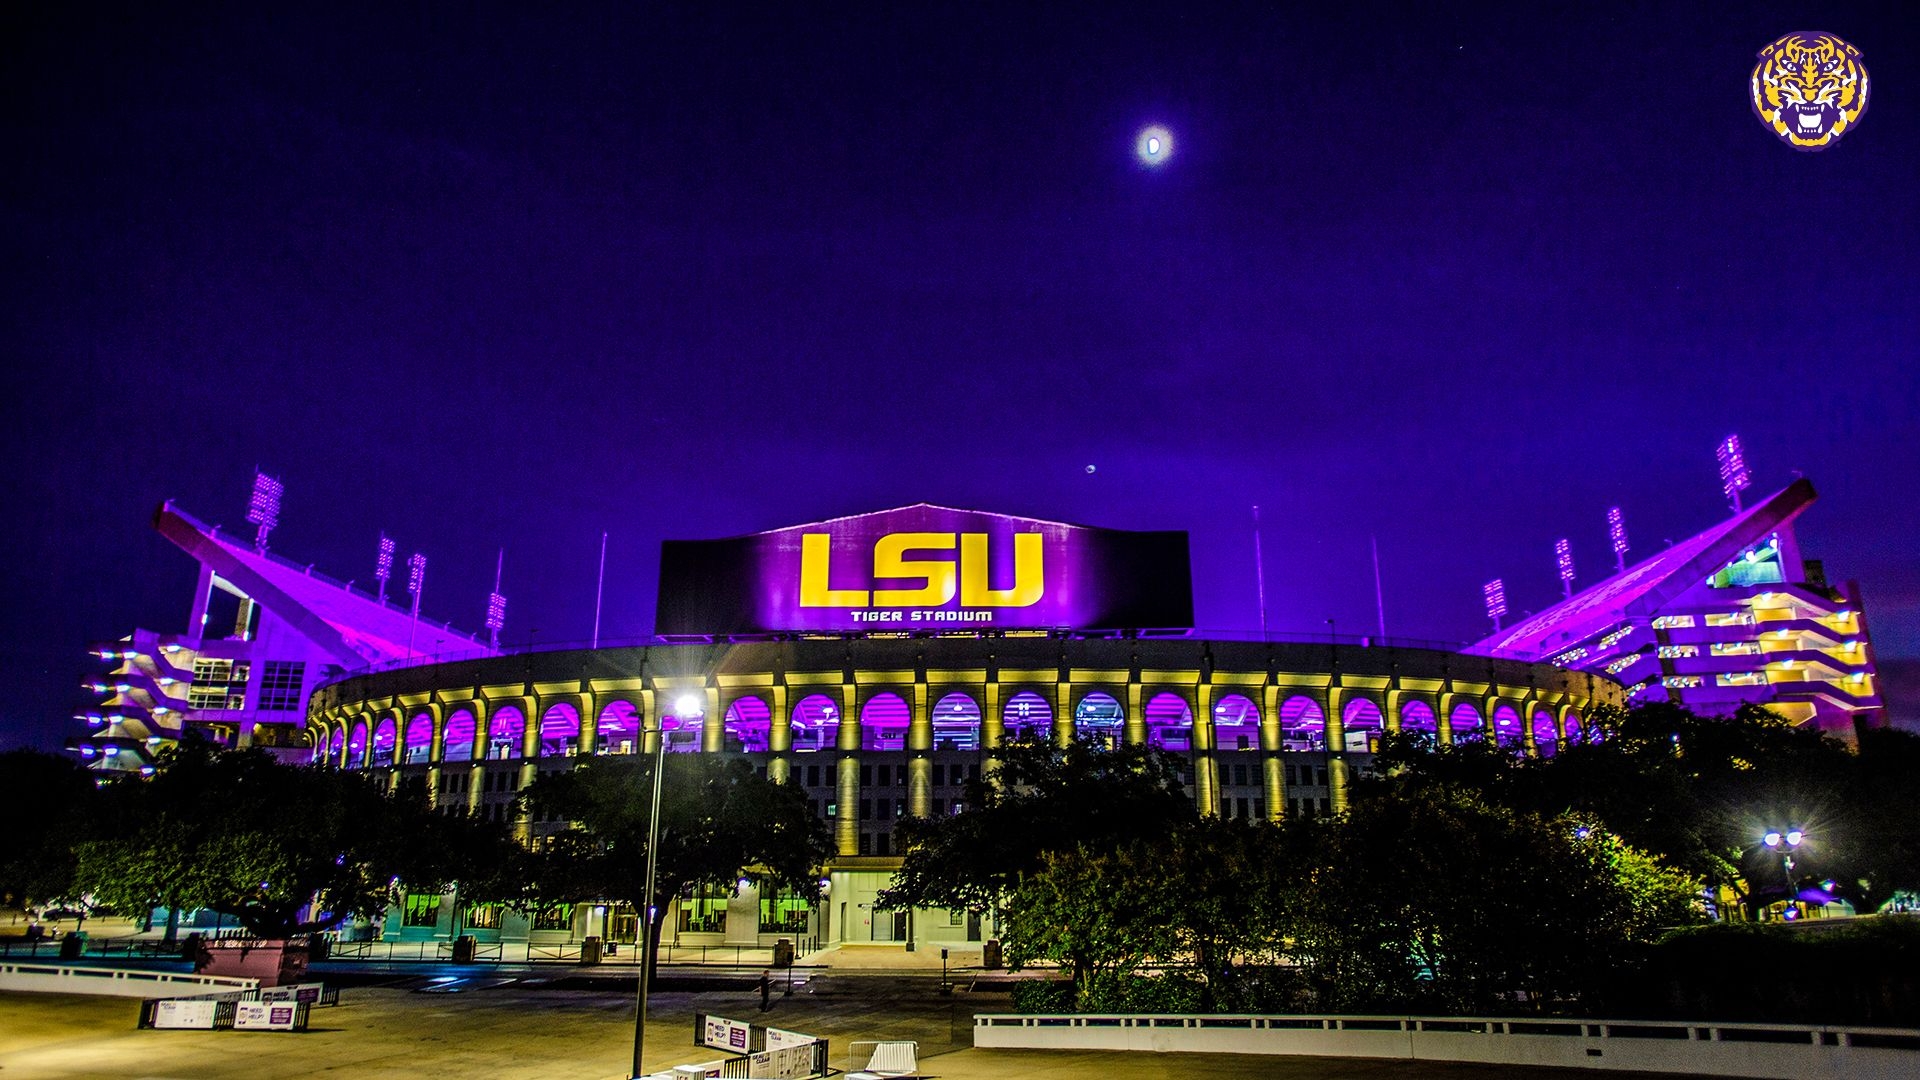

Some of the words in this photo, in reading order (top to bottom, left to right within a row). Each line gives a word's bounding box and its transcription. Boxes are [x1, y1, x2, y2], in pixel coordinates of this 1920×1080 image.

[800, 532, 1044, 607] LSU
[850, 611, 903, 622] TIGER
[910, 611, 992, 622] STADIUM
